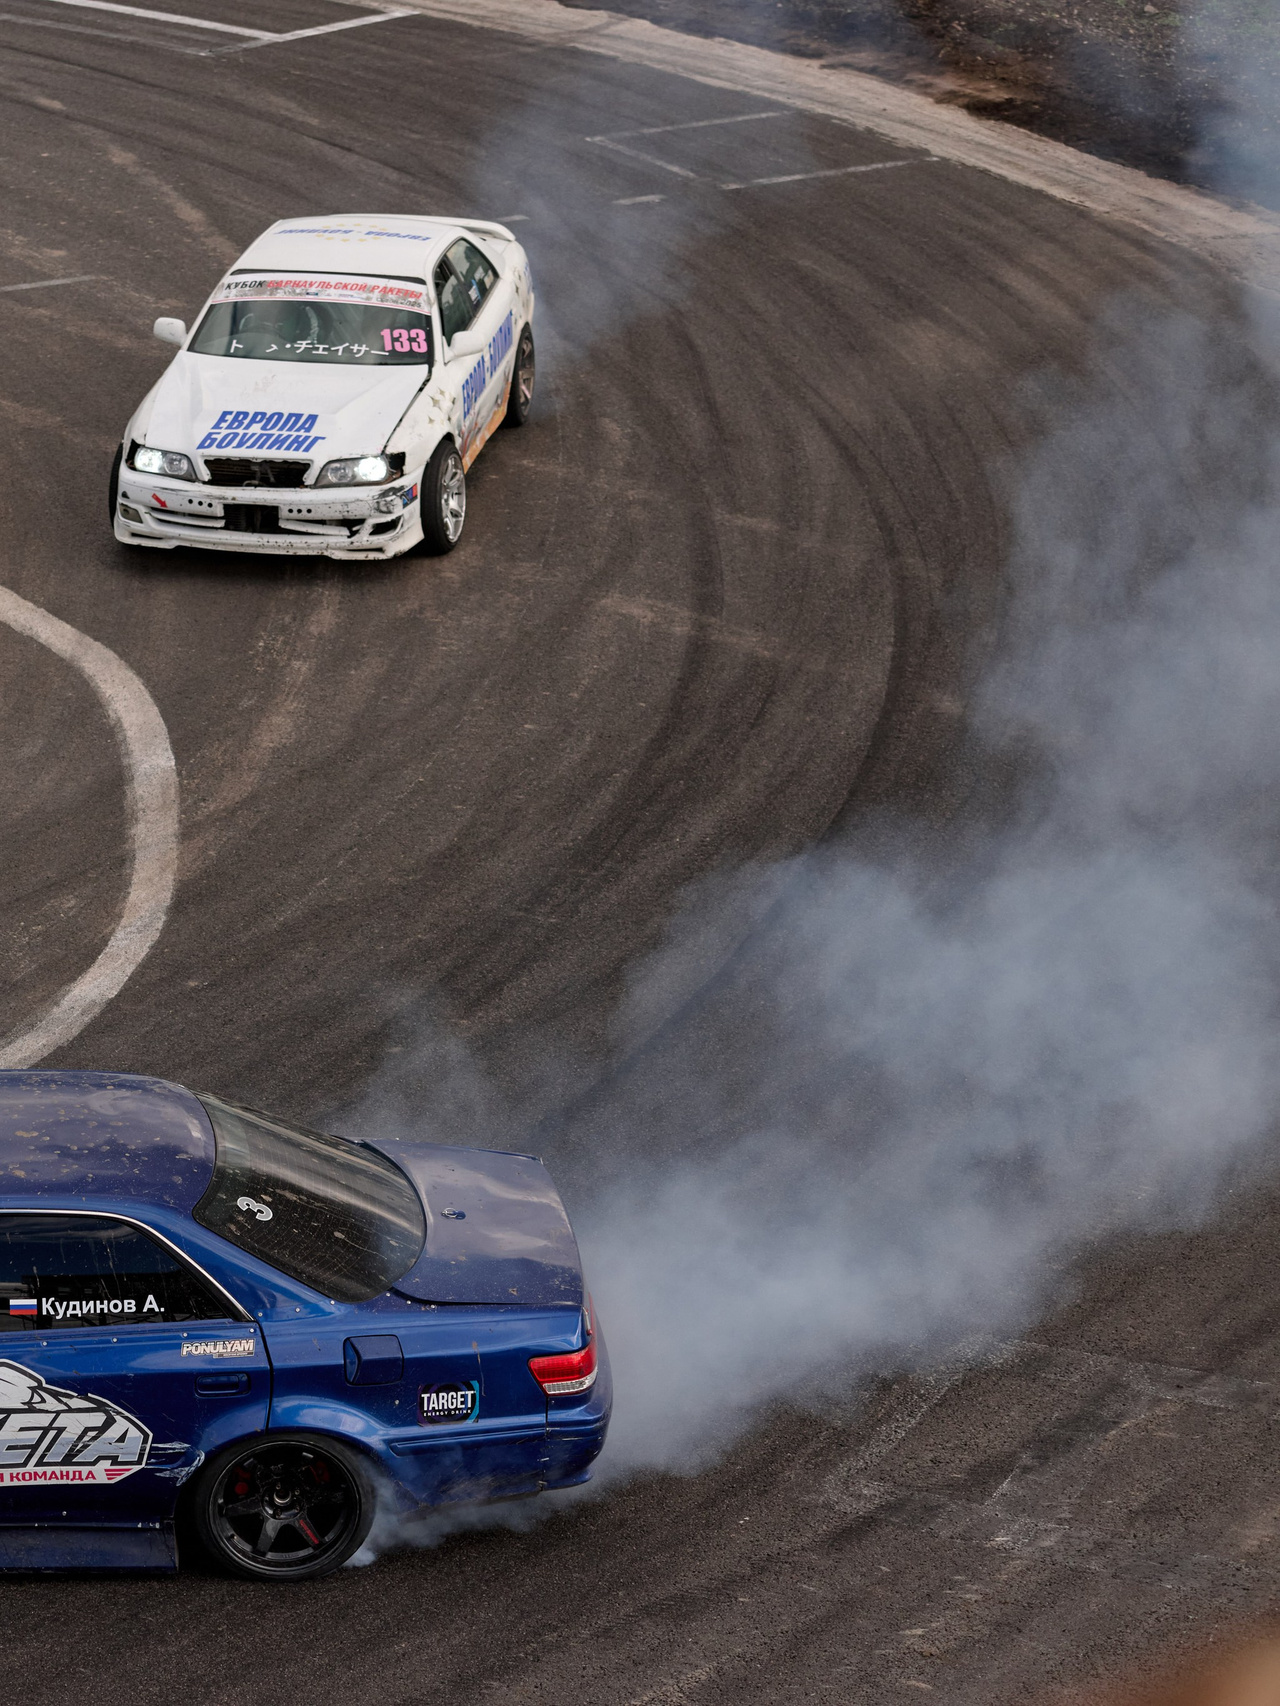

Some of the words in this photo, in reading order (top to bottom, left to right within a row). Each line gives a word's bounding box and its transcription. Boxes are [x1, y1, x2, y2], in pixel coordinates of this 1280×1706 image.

[225, 280, 266, 290] КУБОК
[267, 280, 367, 292] БАРНАУЛЬСКОЙ
[370, 285, 423, 299] РАКЕТЫ
[380, 328, 429, 354] 133
[462, 355, 486, 420] ЕВРОПА
[210, 411, 319, 433] ЕВРОПА
[196, 432, 326, 452] БОУЛИНГ
[237, 1197, 273, 1221] 3
[42, 1297, 136, 1319] Кудинов
[142, 1294, 165, 1313] А.
[182, 1340, 254, 1355] PONULYAM
[421, 1391, 476, 1411] TARGET
[9, 1470, 96, 1482] КОМАНДА
